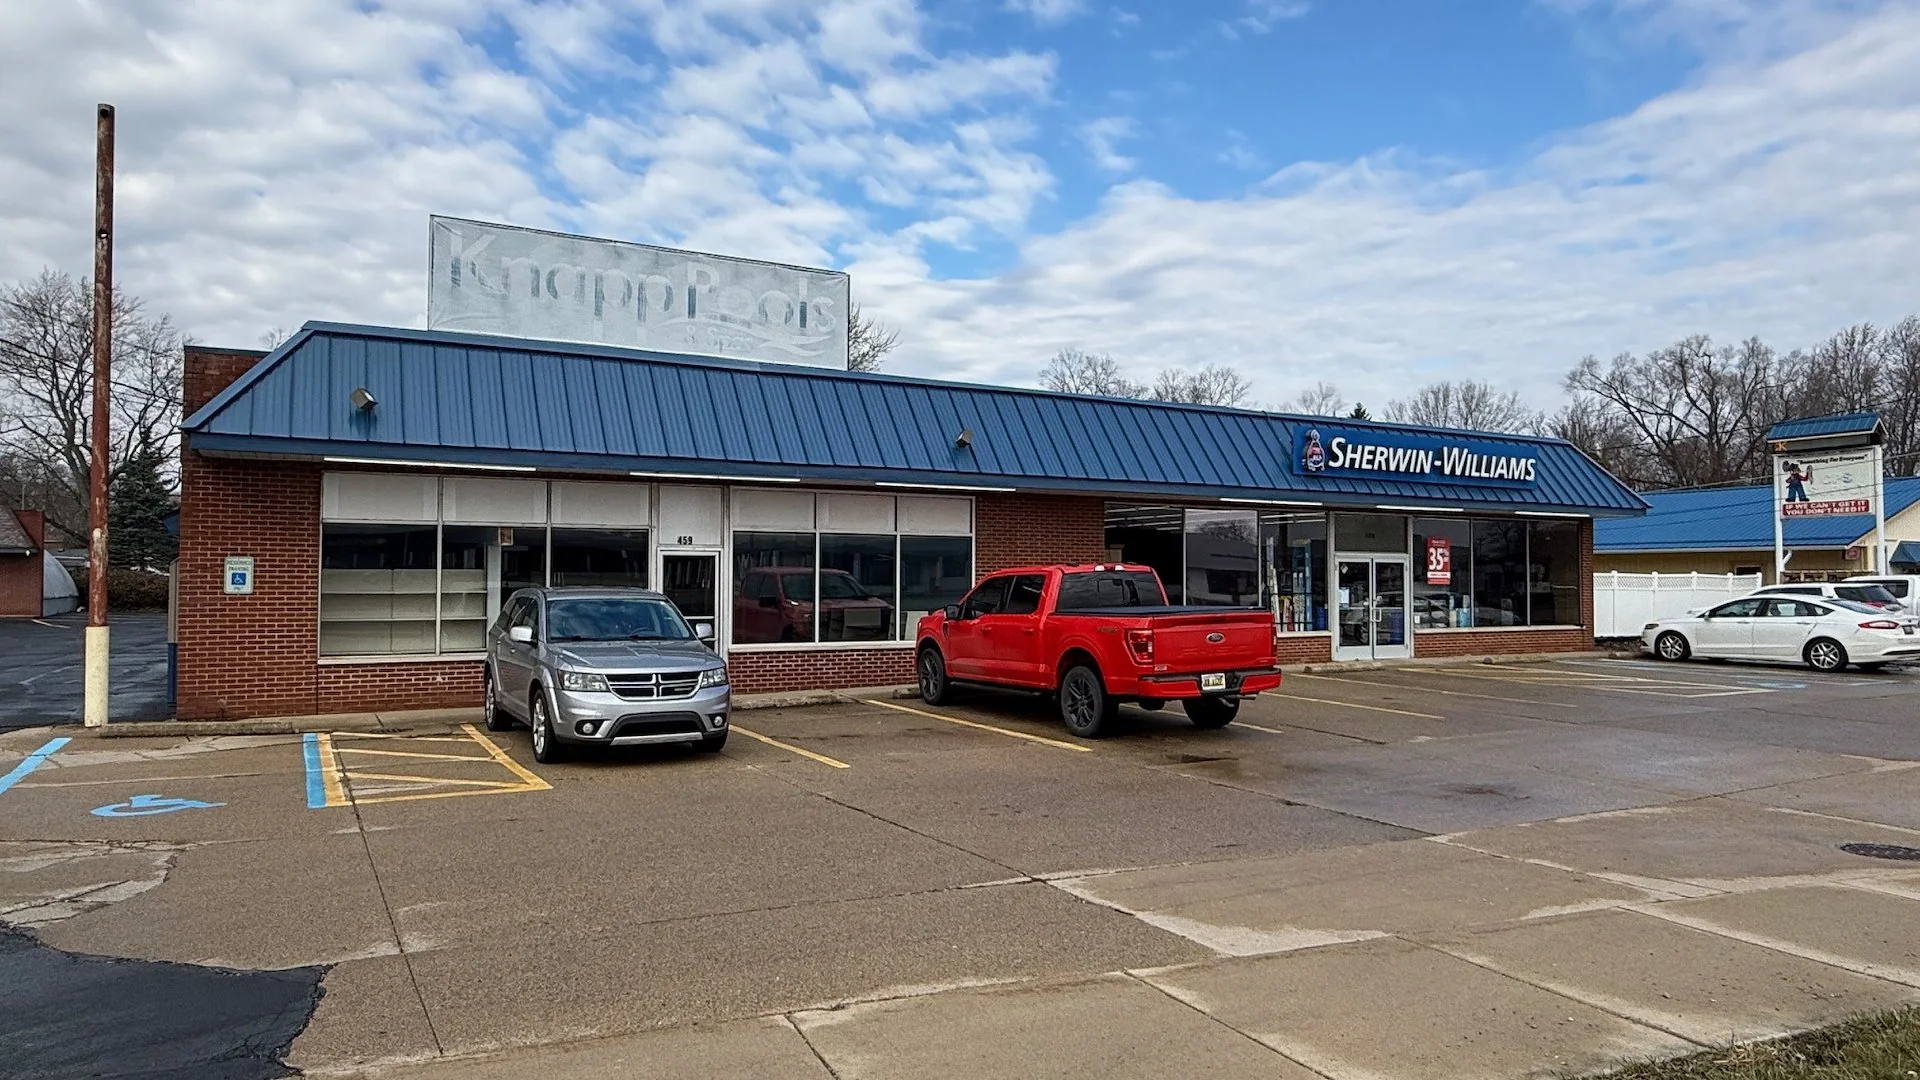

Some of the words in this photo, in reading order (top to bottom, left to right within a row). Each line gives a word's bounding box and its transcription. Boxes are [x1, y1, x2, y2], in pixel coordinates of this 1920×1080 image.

[450, 232, 674, 341] Knapp
[687, 261, 836, 333] Pools
[1329, 437, 1536, 482] SHERWIN-WILLIAMS
[677, 535, 693, 545] 459
